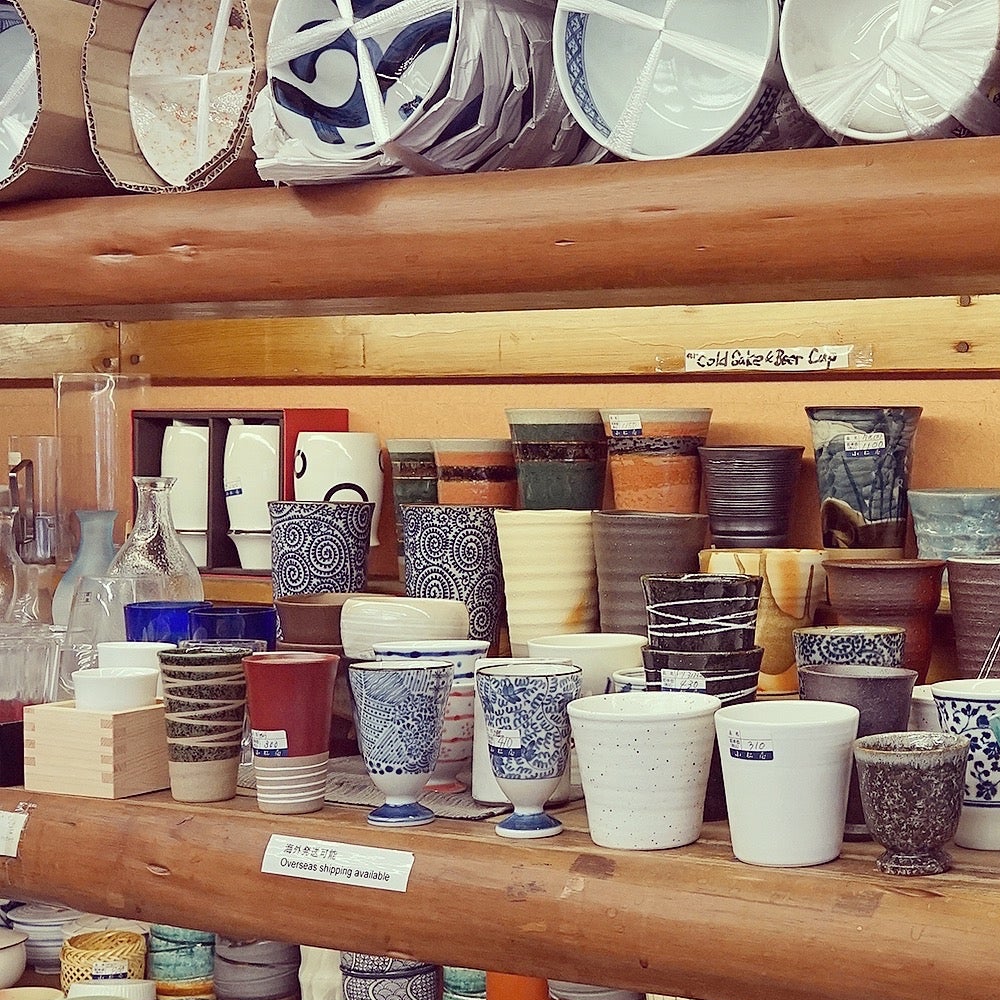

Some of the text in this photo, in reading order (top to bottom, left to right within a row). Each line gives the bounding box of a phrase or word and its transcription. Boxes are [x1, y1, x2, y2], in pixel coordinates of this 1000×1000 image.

[697, 351, 728, 367] Cold
[774, 349, 803, 366] Beer
[747, 742, 766, 751] 310
[284, 843, 337, 860] 海外発送可能
[280, 857, 390, 882] Overseas shipping available
